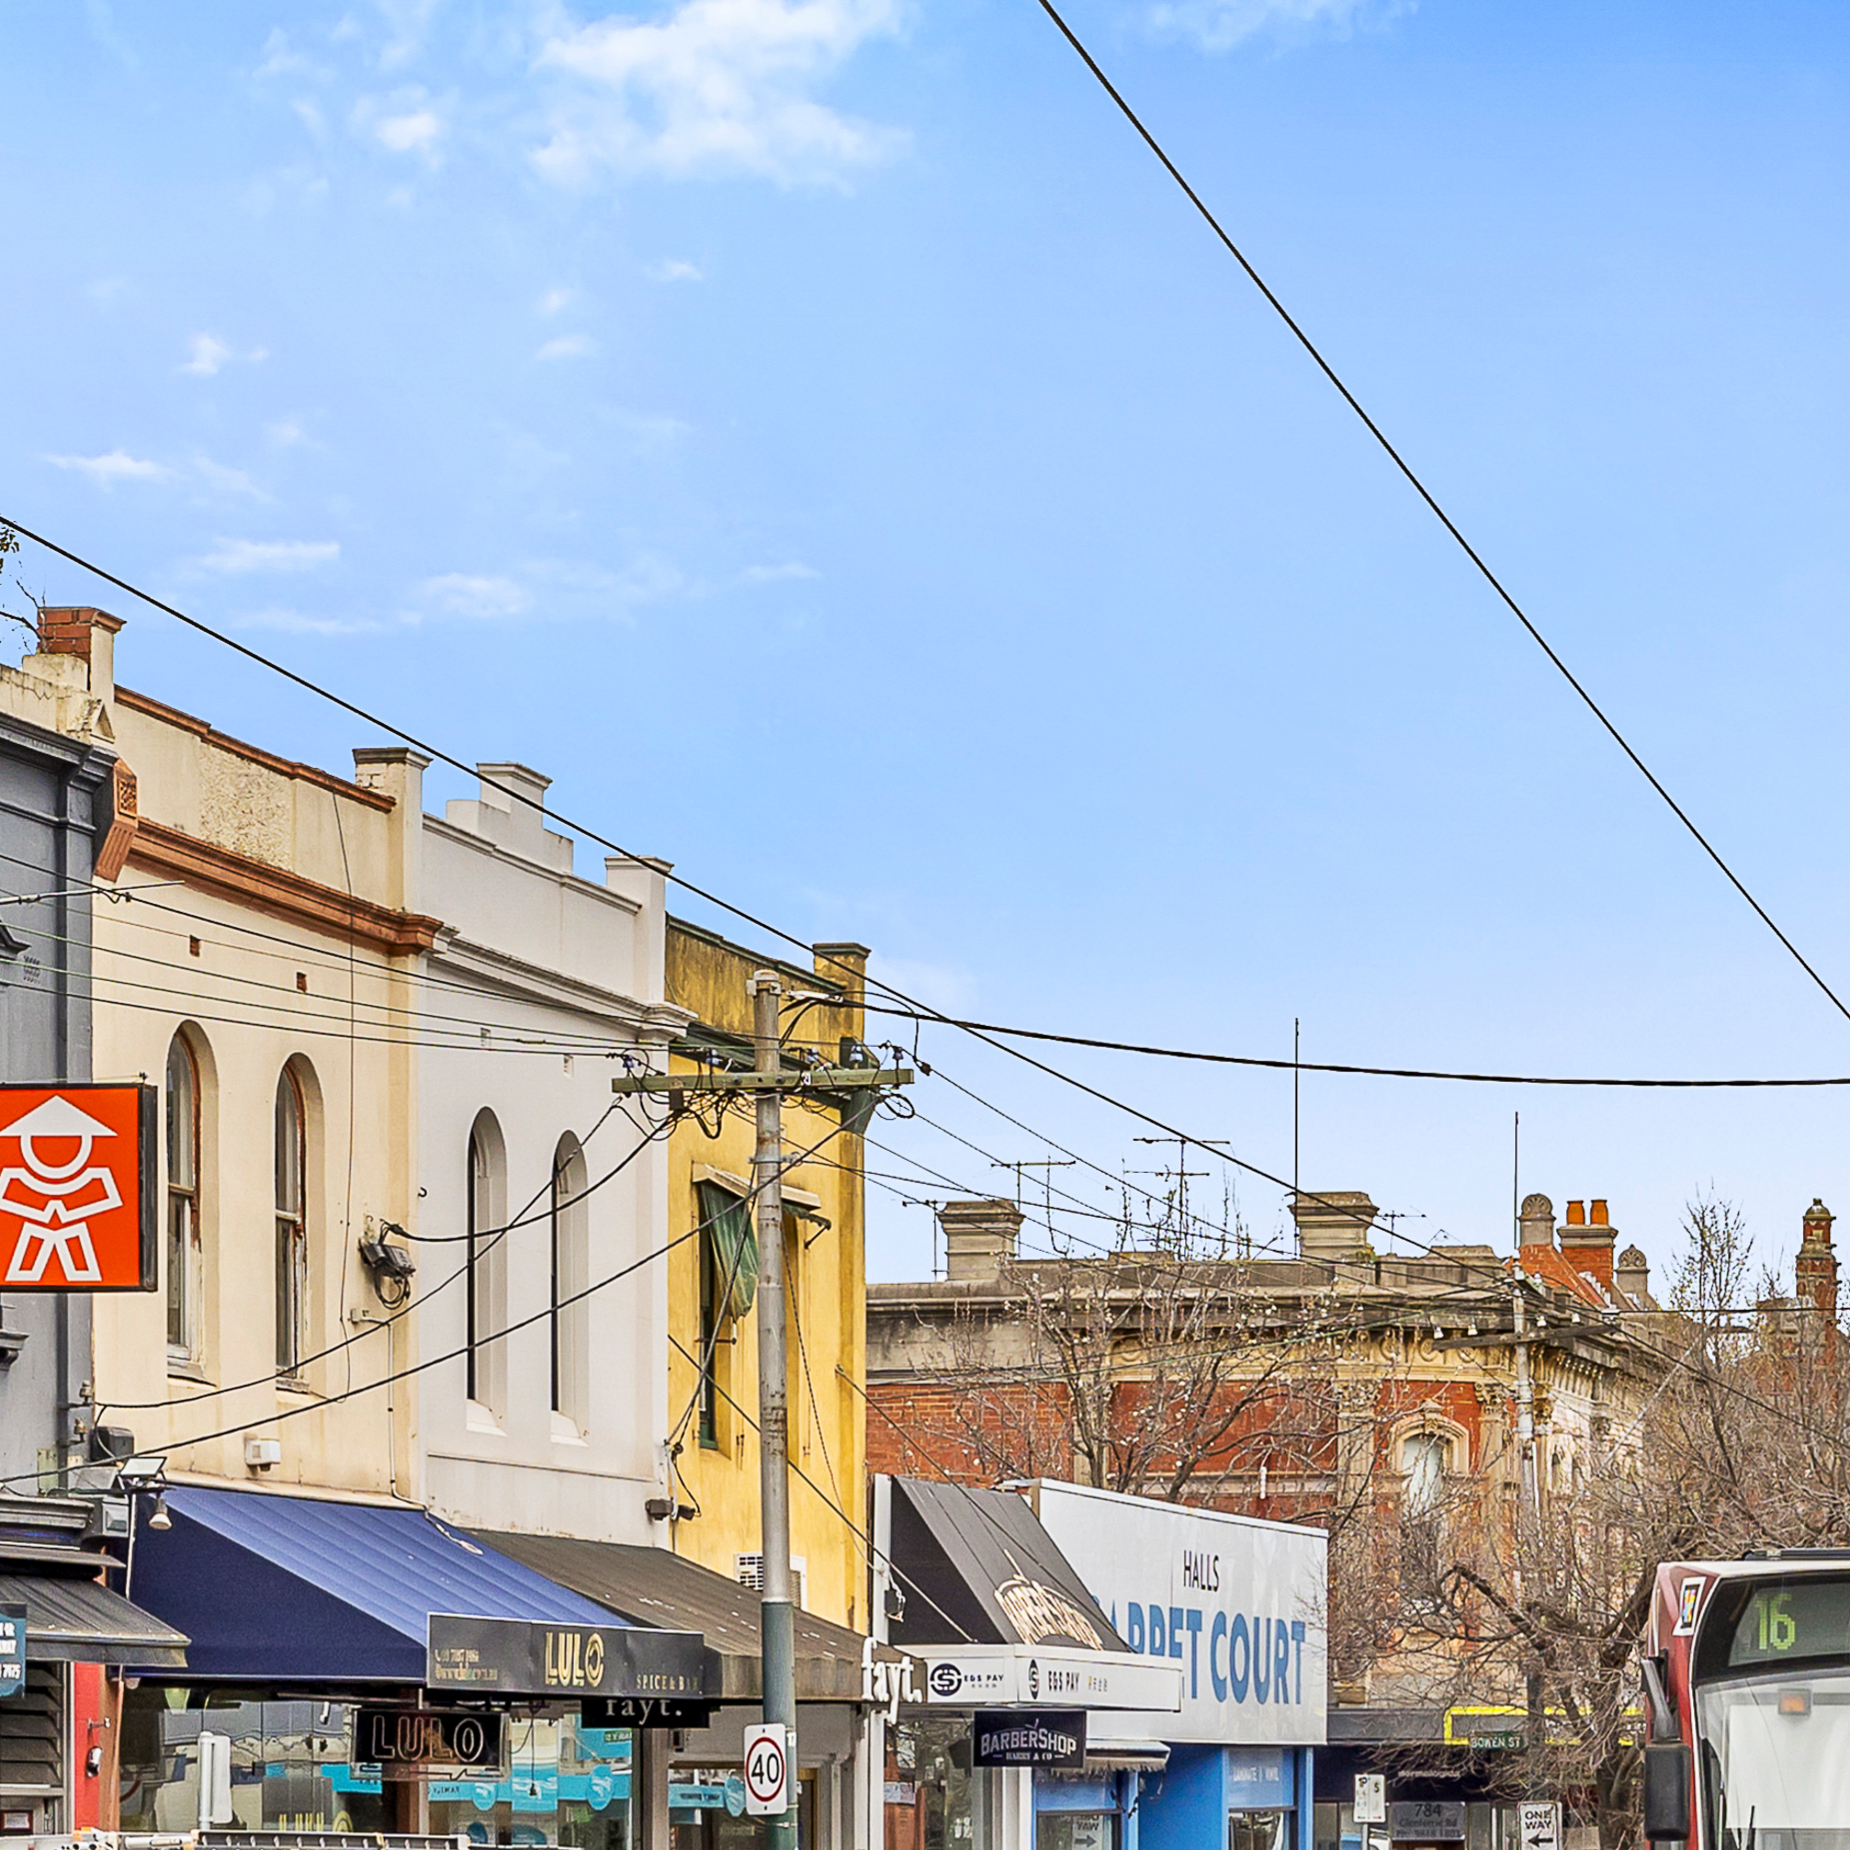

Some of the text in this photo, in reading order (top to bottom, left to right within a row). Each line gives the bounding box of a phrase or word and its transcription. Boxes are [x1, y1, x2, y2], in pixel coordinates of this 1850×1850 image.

[1183, 1550, 1219, 1592] HALLS
[1755, 1593, 1795, 1650] 16
[545, 1632, 604, 1687] LULO
[1210, 1611, 1305, 1705] COURT
[636, 1674, 667, 1690] SPICE
[986, 1674, 1004, 1682] PAY
[1066, 1672, 1080, 1692] PAY
[372, 1714, 484, 1762] LULO
[1472, 1736, 1521, 1748] BOWEN ST
[751, 1753, 780, 1785] 40
[1414, 1802, 1441, 1818] 784
[1525, 1810, 1552, 1819] ONE
[1525, 1822, 1552, 1830] WAY
